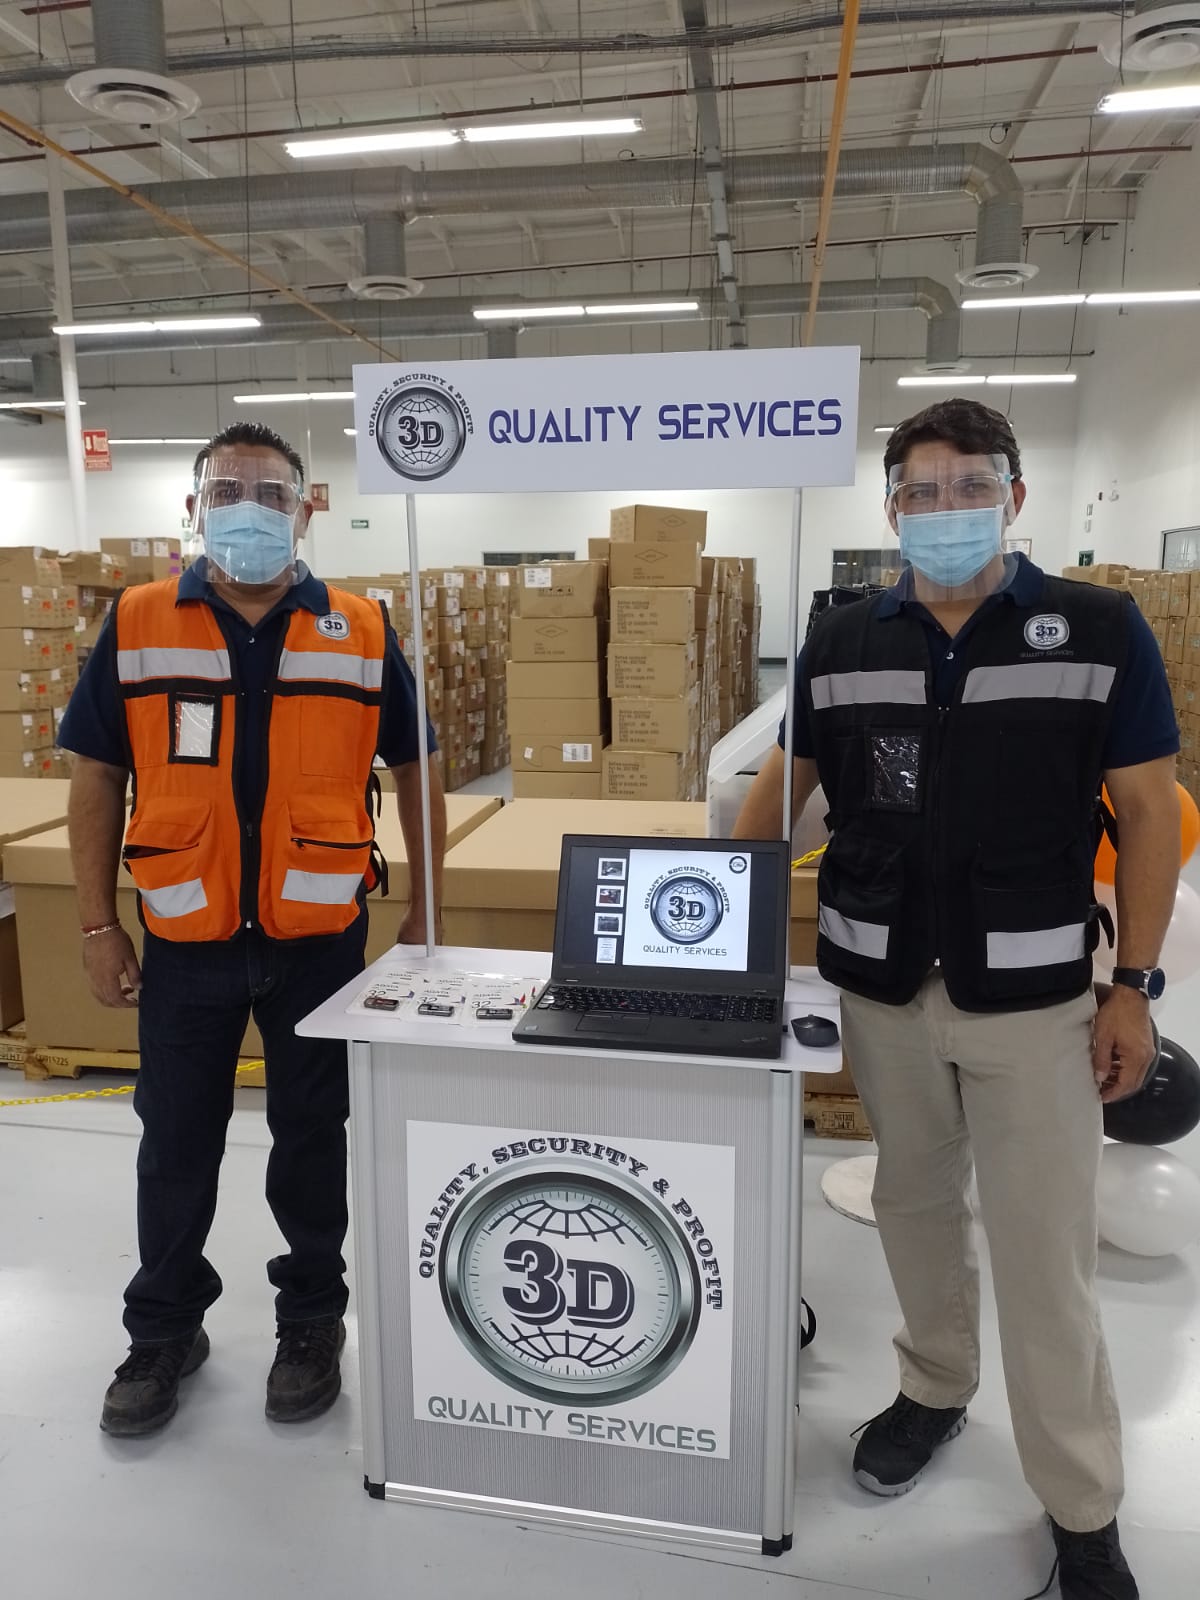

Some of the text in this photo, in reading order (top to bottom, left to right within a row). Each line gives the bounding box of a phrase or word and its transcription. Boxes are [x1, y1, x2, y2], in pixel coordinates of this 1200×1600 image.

[393, 373, 446, 387] SECURITY
[455, 392, 474, 435] PROFIT
[488, 398, 842, 444] QUALITY SERVICES
[398, 415, 445, 450] 3D
[324, 620, 343, 630] 3D
[1035, 624, 1058, 638] 3D
[668, 866, 711, 876] SECURITY
[716, 881, 731, 913] PROFIT
[668, 895, 706, 921] 3D
[643, 945, 727, 957] QUALITY SERVICES
[471, 1000, 492, 1008] 32
[418, 1137, 723, 1310] QUALITY, SECURITY & PROFIT
[502, 1239, 636, 1330] 3D
[428, 1395, 717, 1453] QUALITY SERVICES
